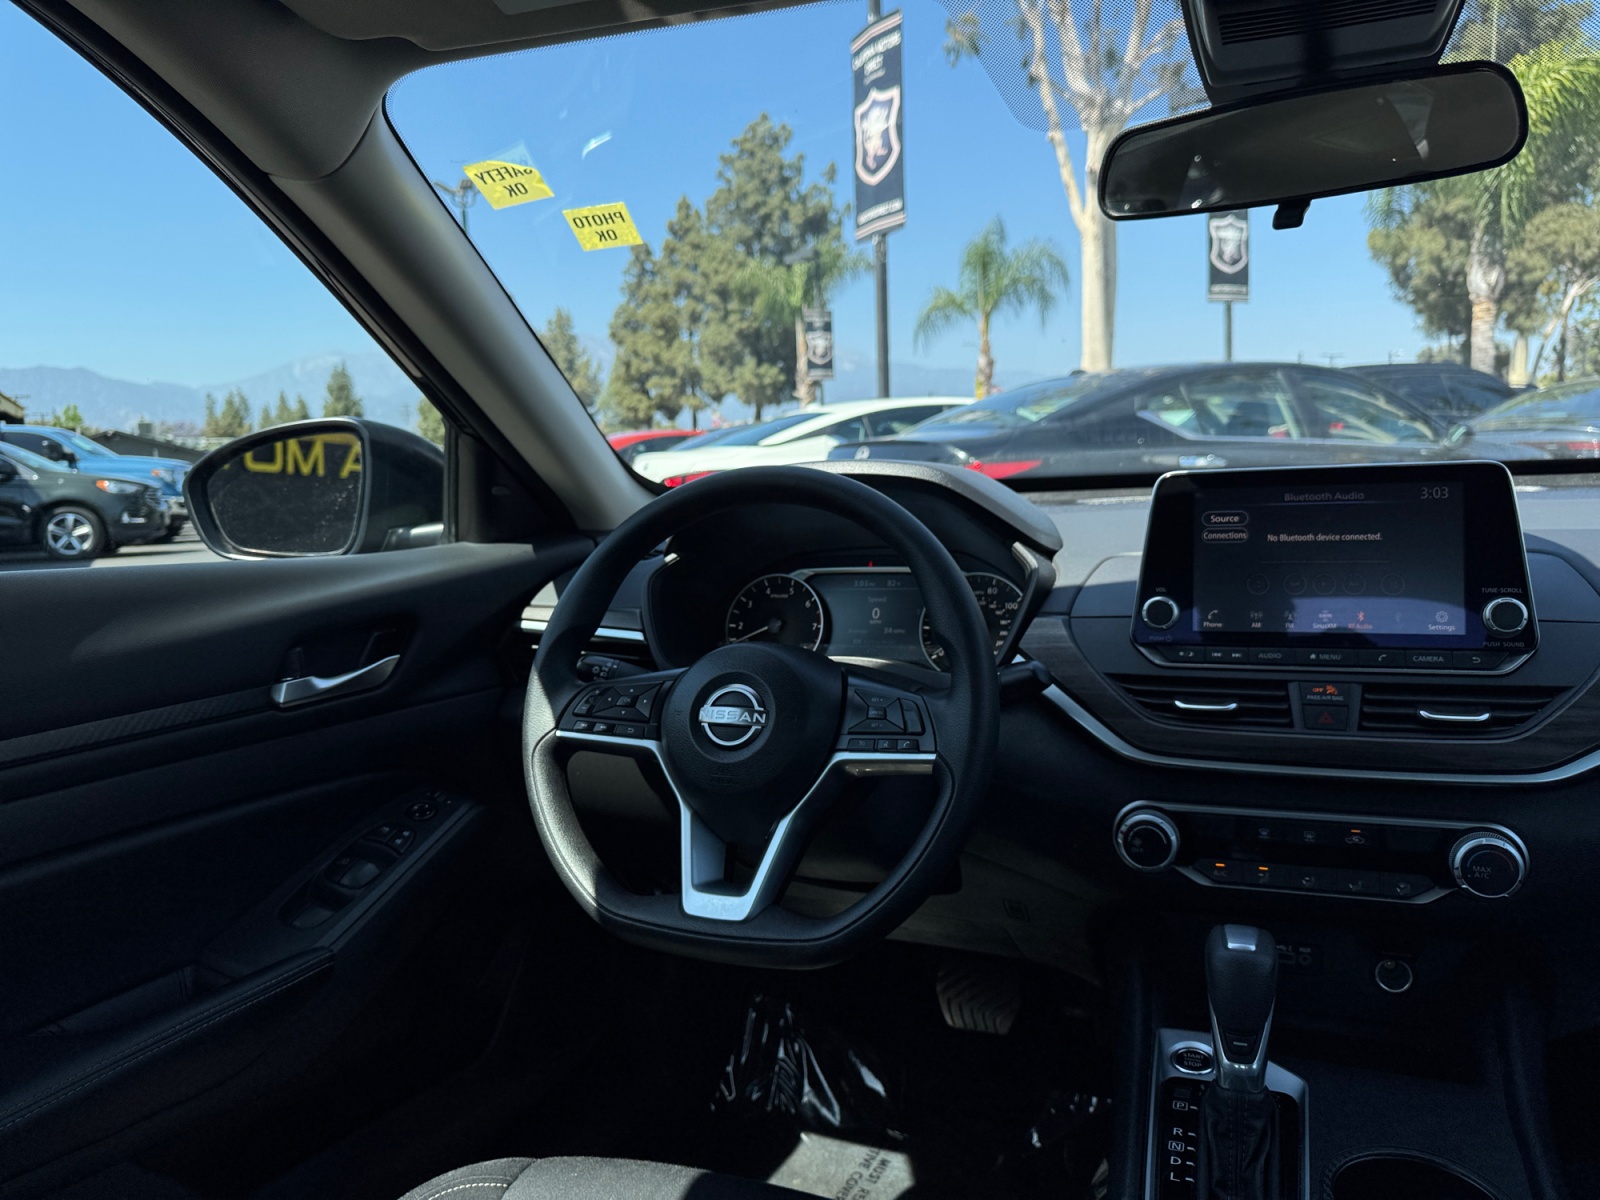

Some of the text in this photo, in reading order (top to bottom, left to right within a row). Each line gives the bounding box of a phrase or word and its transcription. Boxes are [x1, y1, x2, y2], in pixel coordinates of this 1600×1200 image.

[1284, 491, 1365, 501] Bluetooth Audio
[1419, 486, 1449, 500] 3:03
[1210, 514, 1240, 523] Source
[1203, 531, 1247, 540] Connections
[1267, 532, 1383, 542] No Bluetooth device connected.
[987, 587, 998, 595] 80
[1005, 602, 1019, 611] 100
[871, 607, 881, 620] 0
[1203, 621, 1223, 629] Phone
[1428, 623, 1456, 632] Settings
[1258, 652, 1282, 660] AUDIO
[1319, 653, 1342, 661] MENU
[1412, 655, 1444, 663] CAMERA
[699, 709, 767, 724] NISSAN
[1472, 865, 1492, 874] MAX
[1473, 871, 1490, 880] A/C
[1182, 1052, 1204, 1060] START
[1183, 1060, 1203, 1068] STOP
[1172, 1126, 1184, 1137] R
[1169, 1156, 1182, 1165] D
[1169, 1171, 1181, 1183] L
